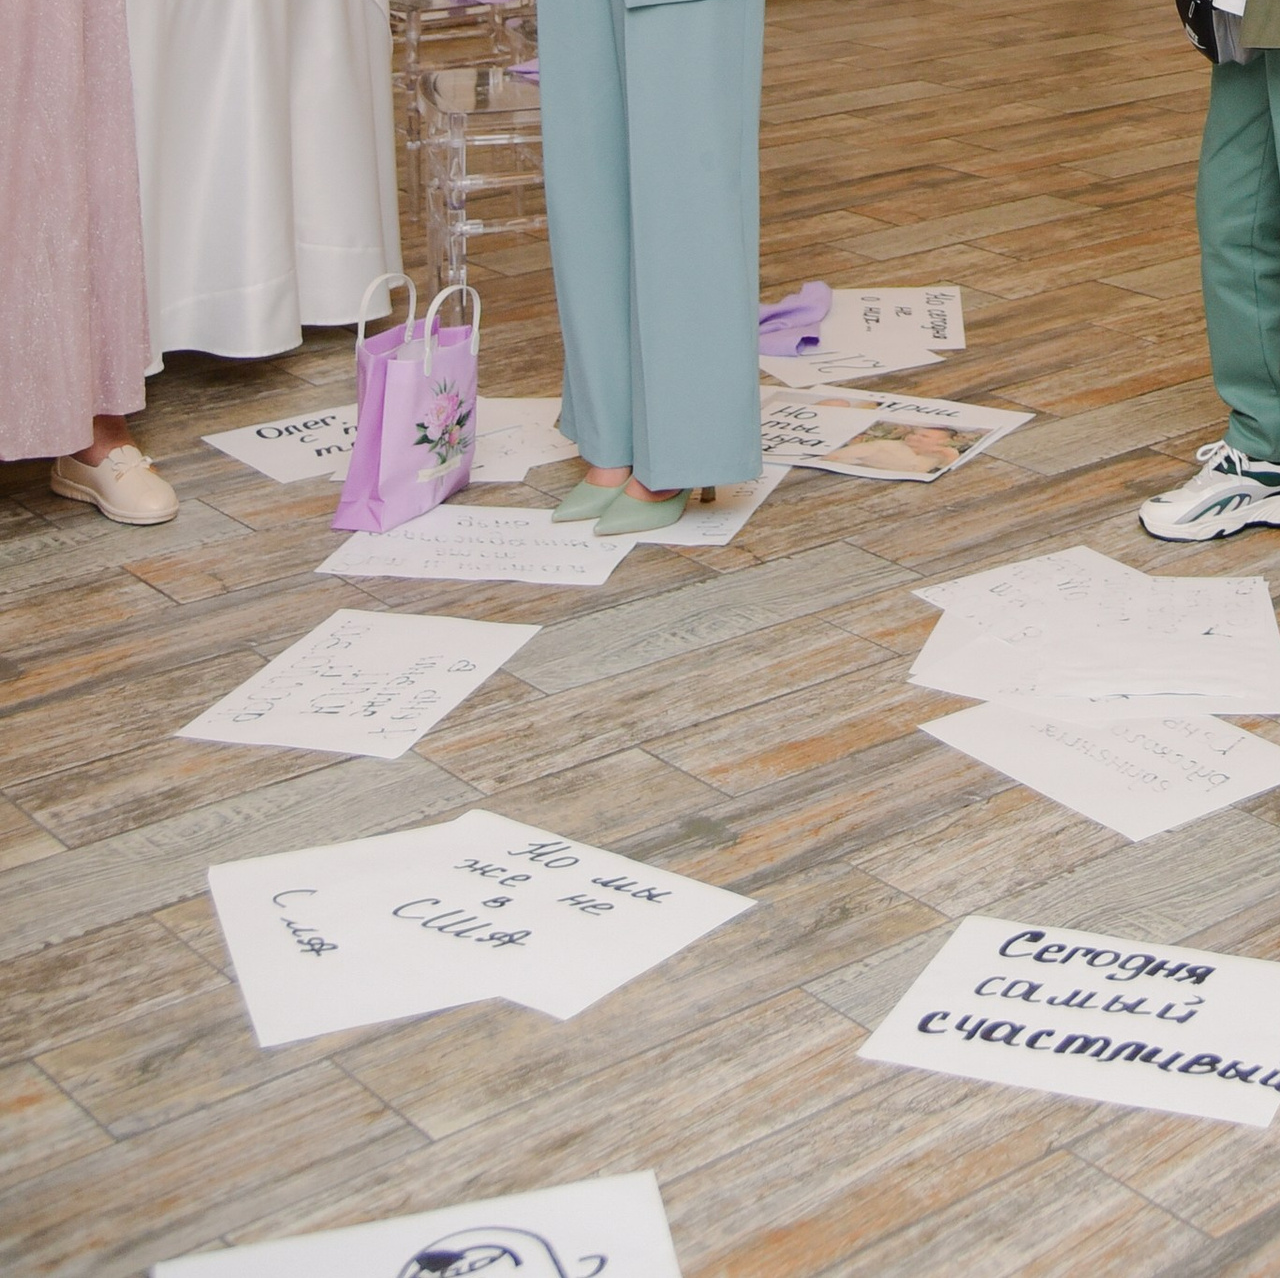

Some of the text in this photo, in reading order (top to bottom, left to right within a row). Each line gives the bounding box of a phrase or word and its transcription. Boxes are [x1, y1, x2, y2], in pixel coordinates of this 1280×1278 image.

[454, 858, 615, 917] же не
[509, 840, 672, 907] Но мы
[999, 929, 1215, 988] Сегодня
[974, 974, 1202, 1024] самый
